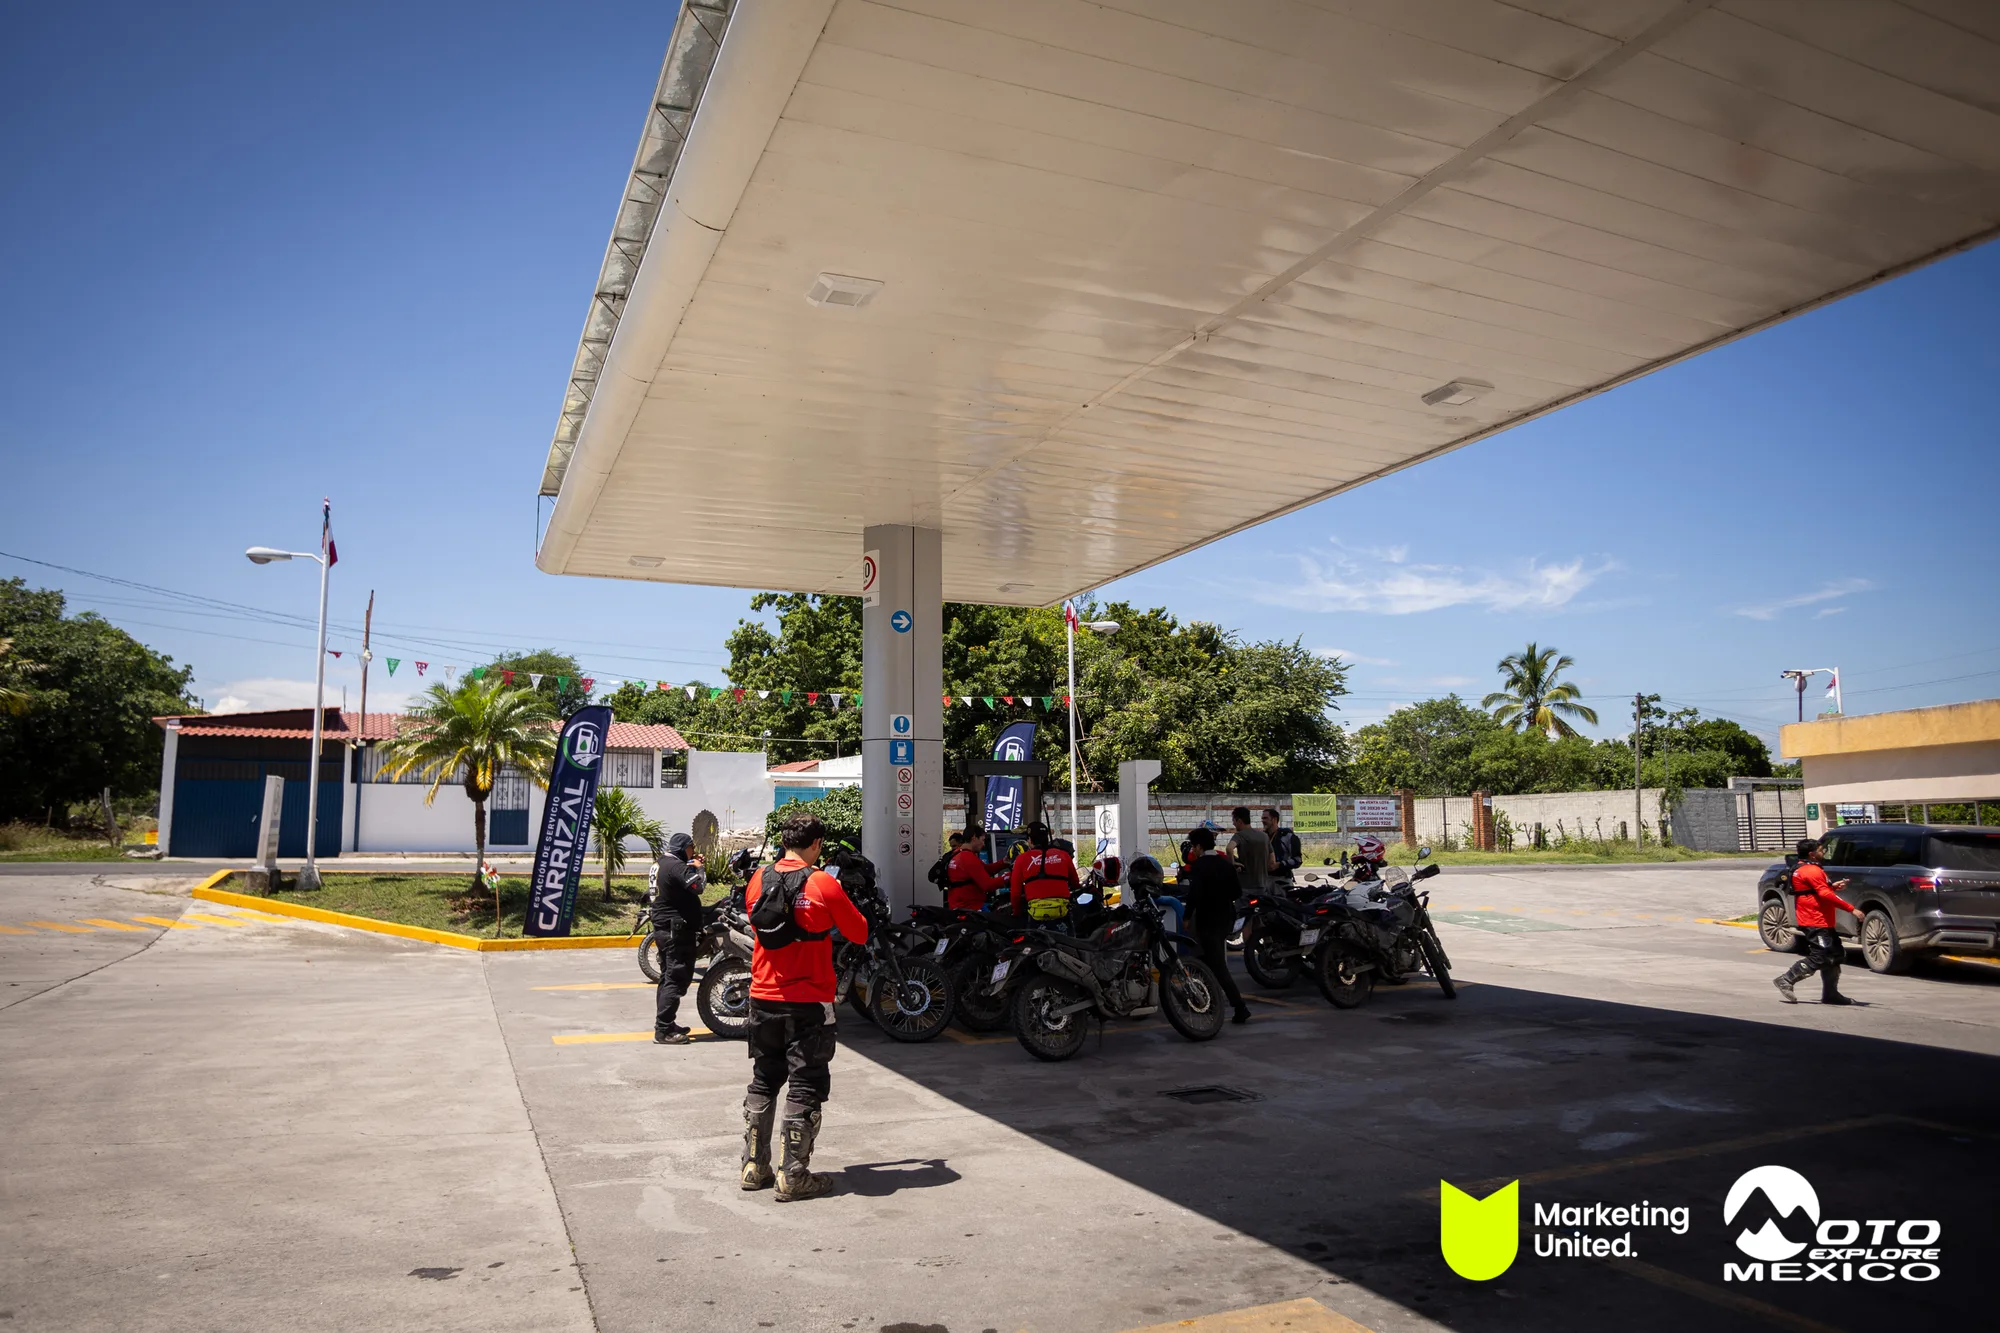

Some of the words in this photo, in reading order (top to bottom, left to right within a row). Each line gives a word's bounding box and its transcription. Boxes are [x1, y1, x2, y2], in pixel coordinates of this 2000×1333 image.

[545, 796, 560, 842] SERVICIO
[573, 853, 582, 872] QUE
[578, 832, 586, 850] NOS
[582, 797, 593, 828] MUEVE
[538, 778, 585, 930] CARRIZAL
[542, 845, 550, 858] DE
[533, 861, 547, 908] ESTACIÓN
